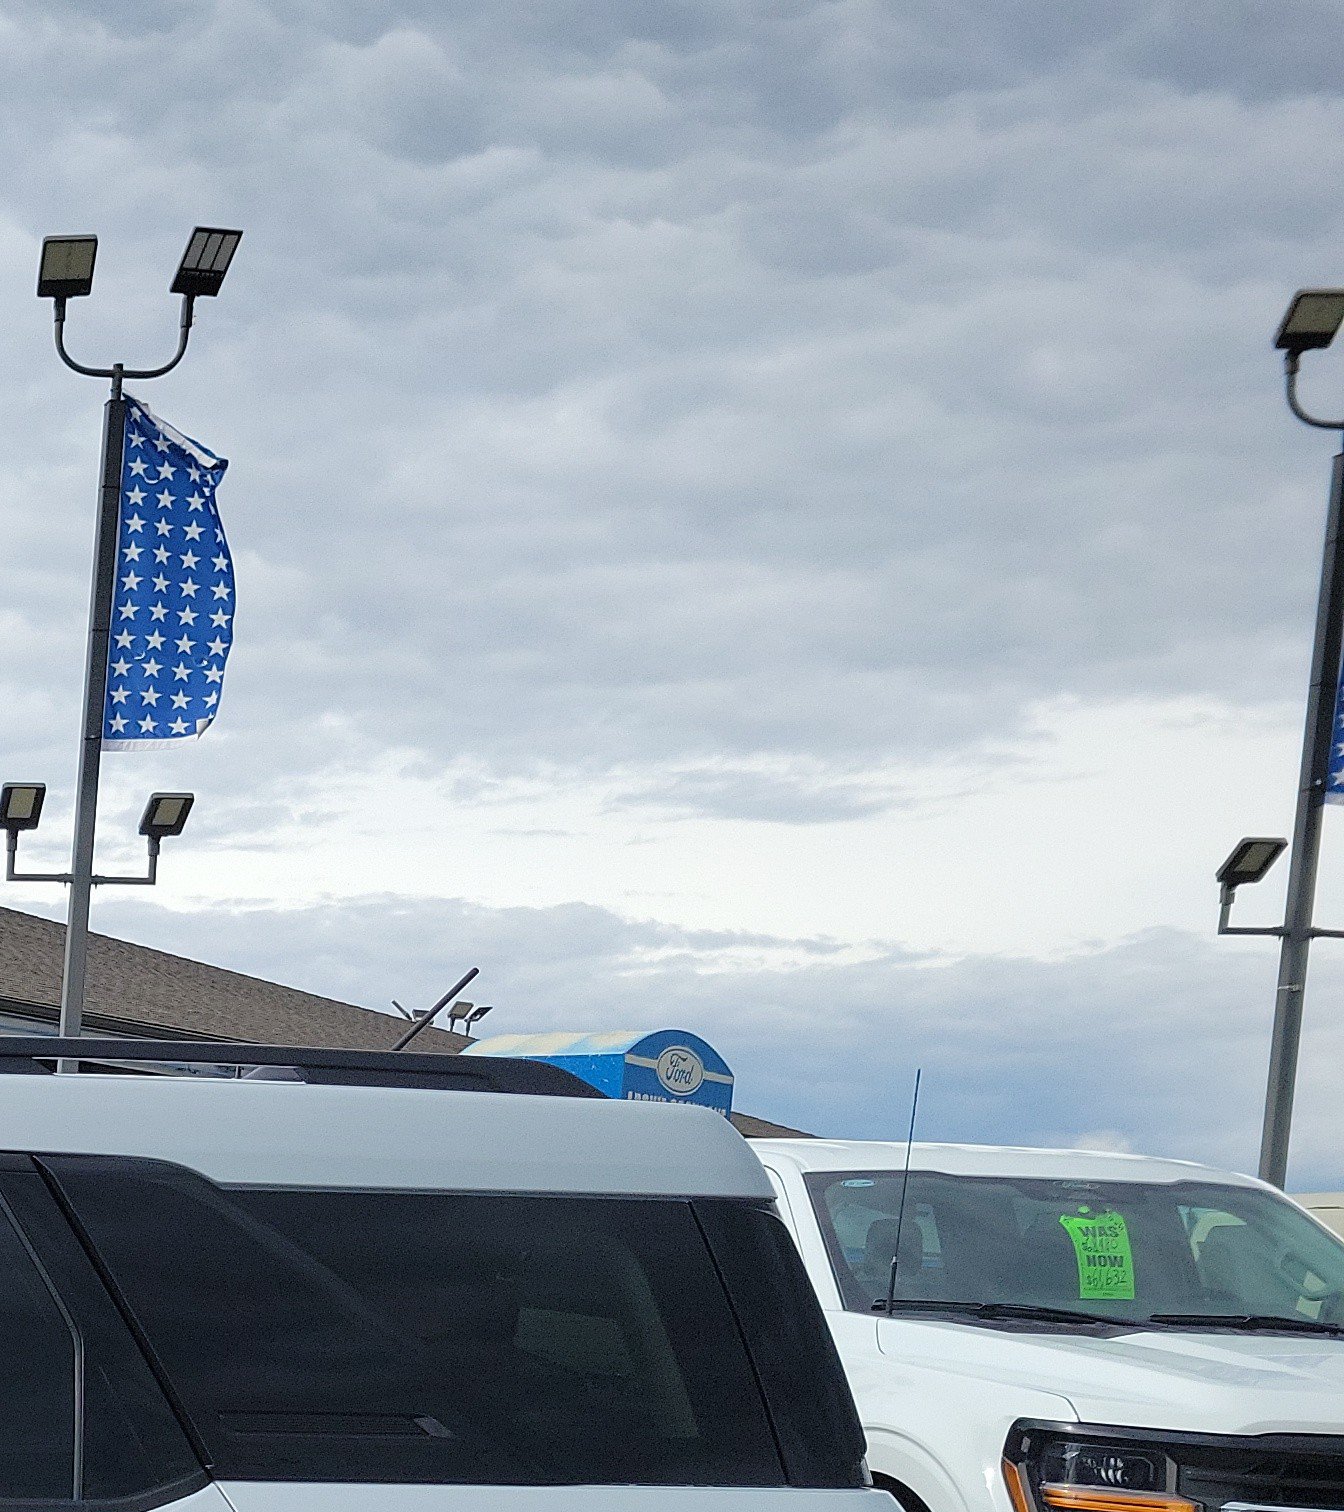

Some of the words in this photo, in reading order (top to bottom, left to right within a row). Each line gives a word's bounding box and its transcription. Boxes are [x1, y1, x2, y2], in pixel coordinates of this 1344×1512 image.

[666, 1053, 694, 1084] Ford
[1077, 1226, 1120, 1238] WAS
[1086, 1254, 1124, 1268] NOW
